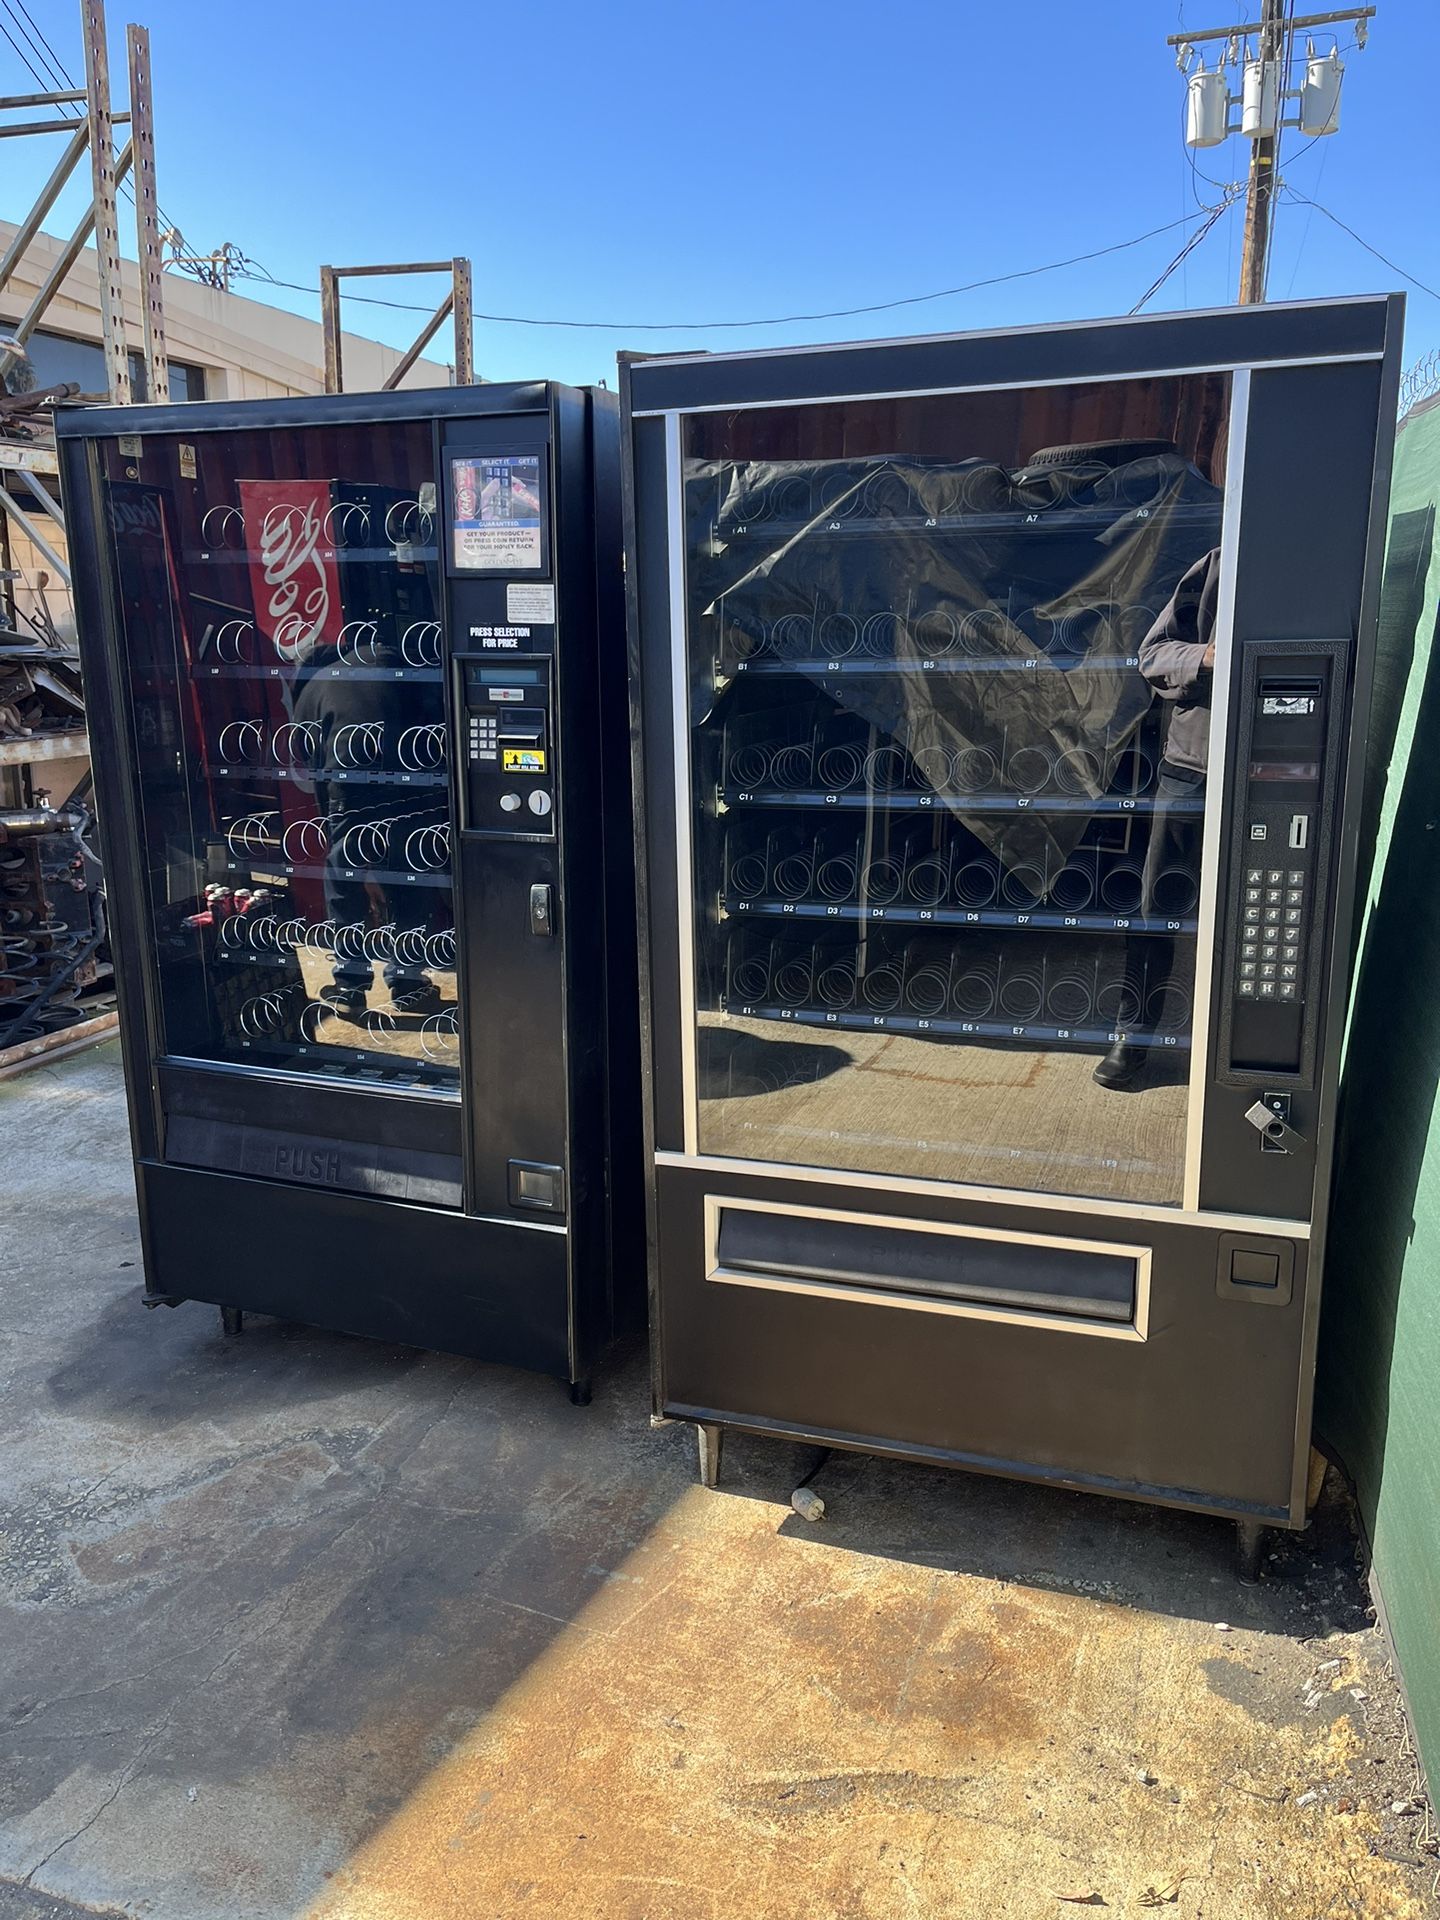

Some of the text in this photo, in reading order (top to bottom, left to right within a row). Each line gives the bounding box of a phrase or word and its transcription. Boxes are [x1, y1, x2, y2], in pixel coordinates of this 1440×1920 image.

[830, 522, 840, 530] A3
[470, 627, 530, 637] PRESS SELECTION
[482, 638, 518, 648] FOR PRICE
[828, 662, 839, 670] B3
[1126, 658, 1138, 666] B9
[739, 793, 1135, 808] C1 C3 C5 C7 C9
[827, 907, 838, 915] D3
[872, 909, 884, 917] D4
[920, 911, 931, 919] D5
[967, 913, 979, 921] D6
[1018, 915, 1030, 923] D7
[1064, 917, 1076, 925] D8
[1117, 919, 1129, 927] D9
[1167, 921, 1180, 929] D0
[781, 1010, 791, 1018] E2
[873, 1017, 884, 1025] E4
[918, 1020, 929, 1028] E5
[962, 1023, 973, 1031] E6
[1012, 1027, 1024, 1035] E7
[1057, 1030, 1069, 1038] E8
[1108, 1033, 1119, 1041] E9
[1164, 1037, 1176, 1045] E0
[274, 1144, 340, 1184] PUSH
